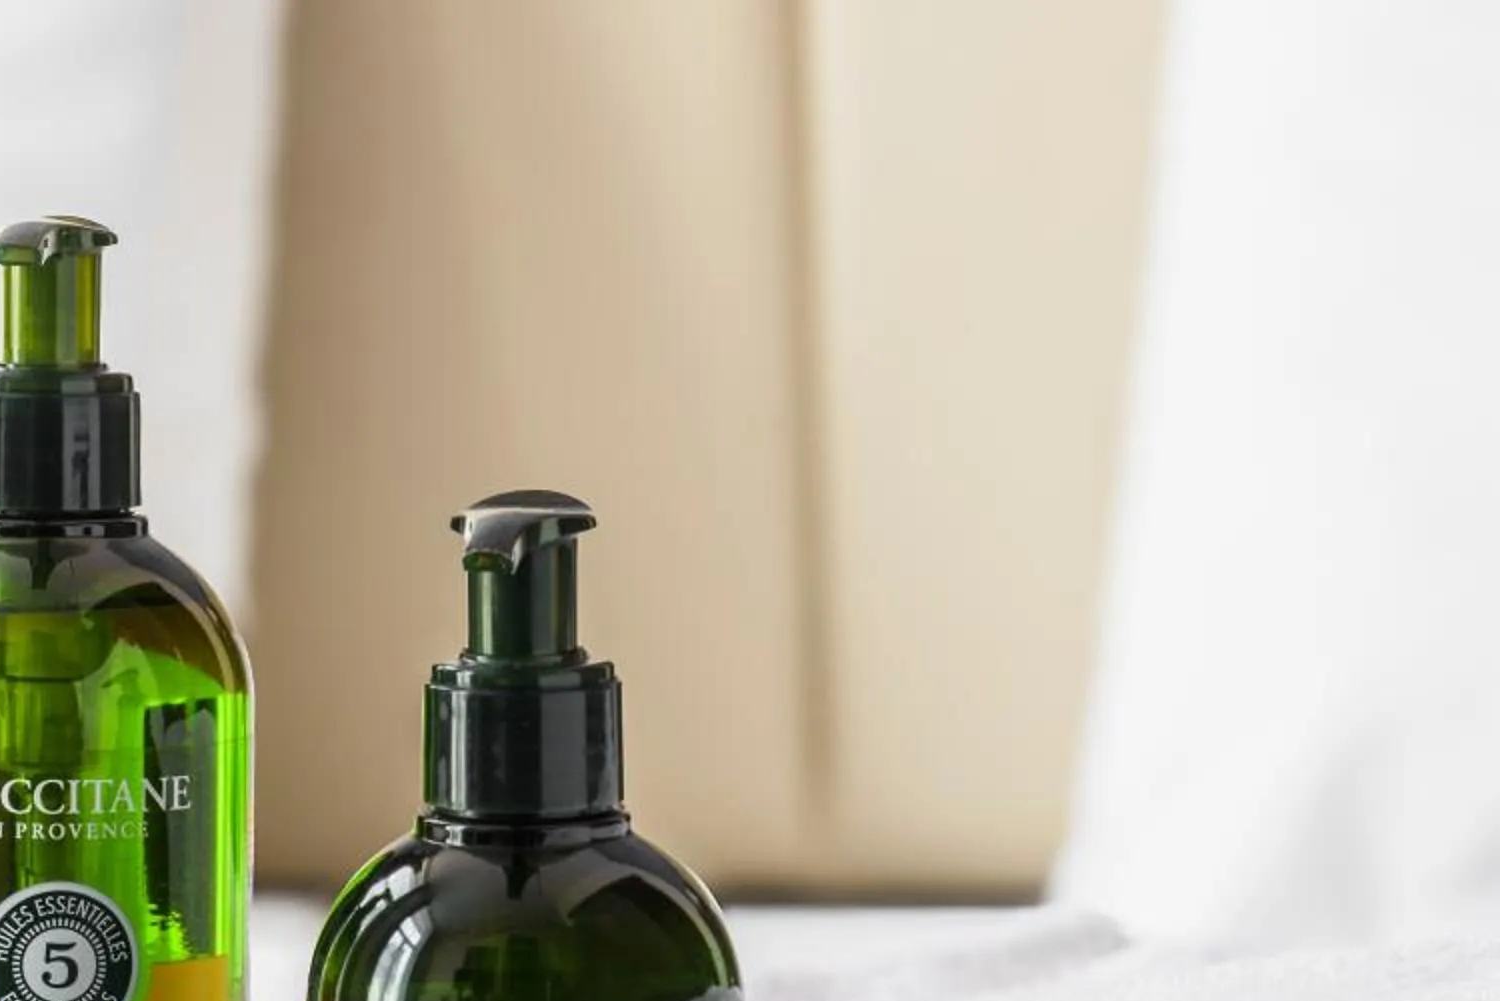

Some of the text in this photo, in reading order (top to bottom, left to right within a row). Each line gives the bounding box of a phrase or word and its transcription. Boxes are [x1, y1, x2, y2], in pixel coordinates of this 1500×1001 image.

[15, 820, 149, 840] PROVENCE
[35, 896, 129, 964] ESSENTIELLES
[41, 942, 79, 989] 5
